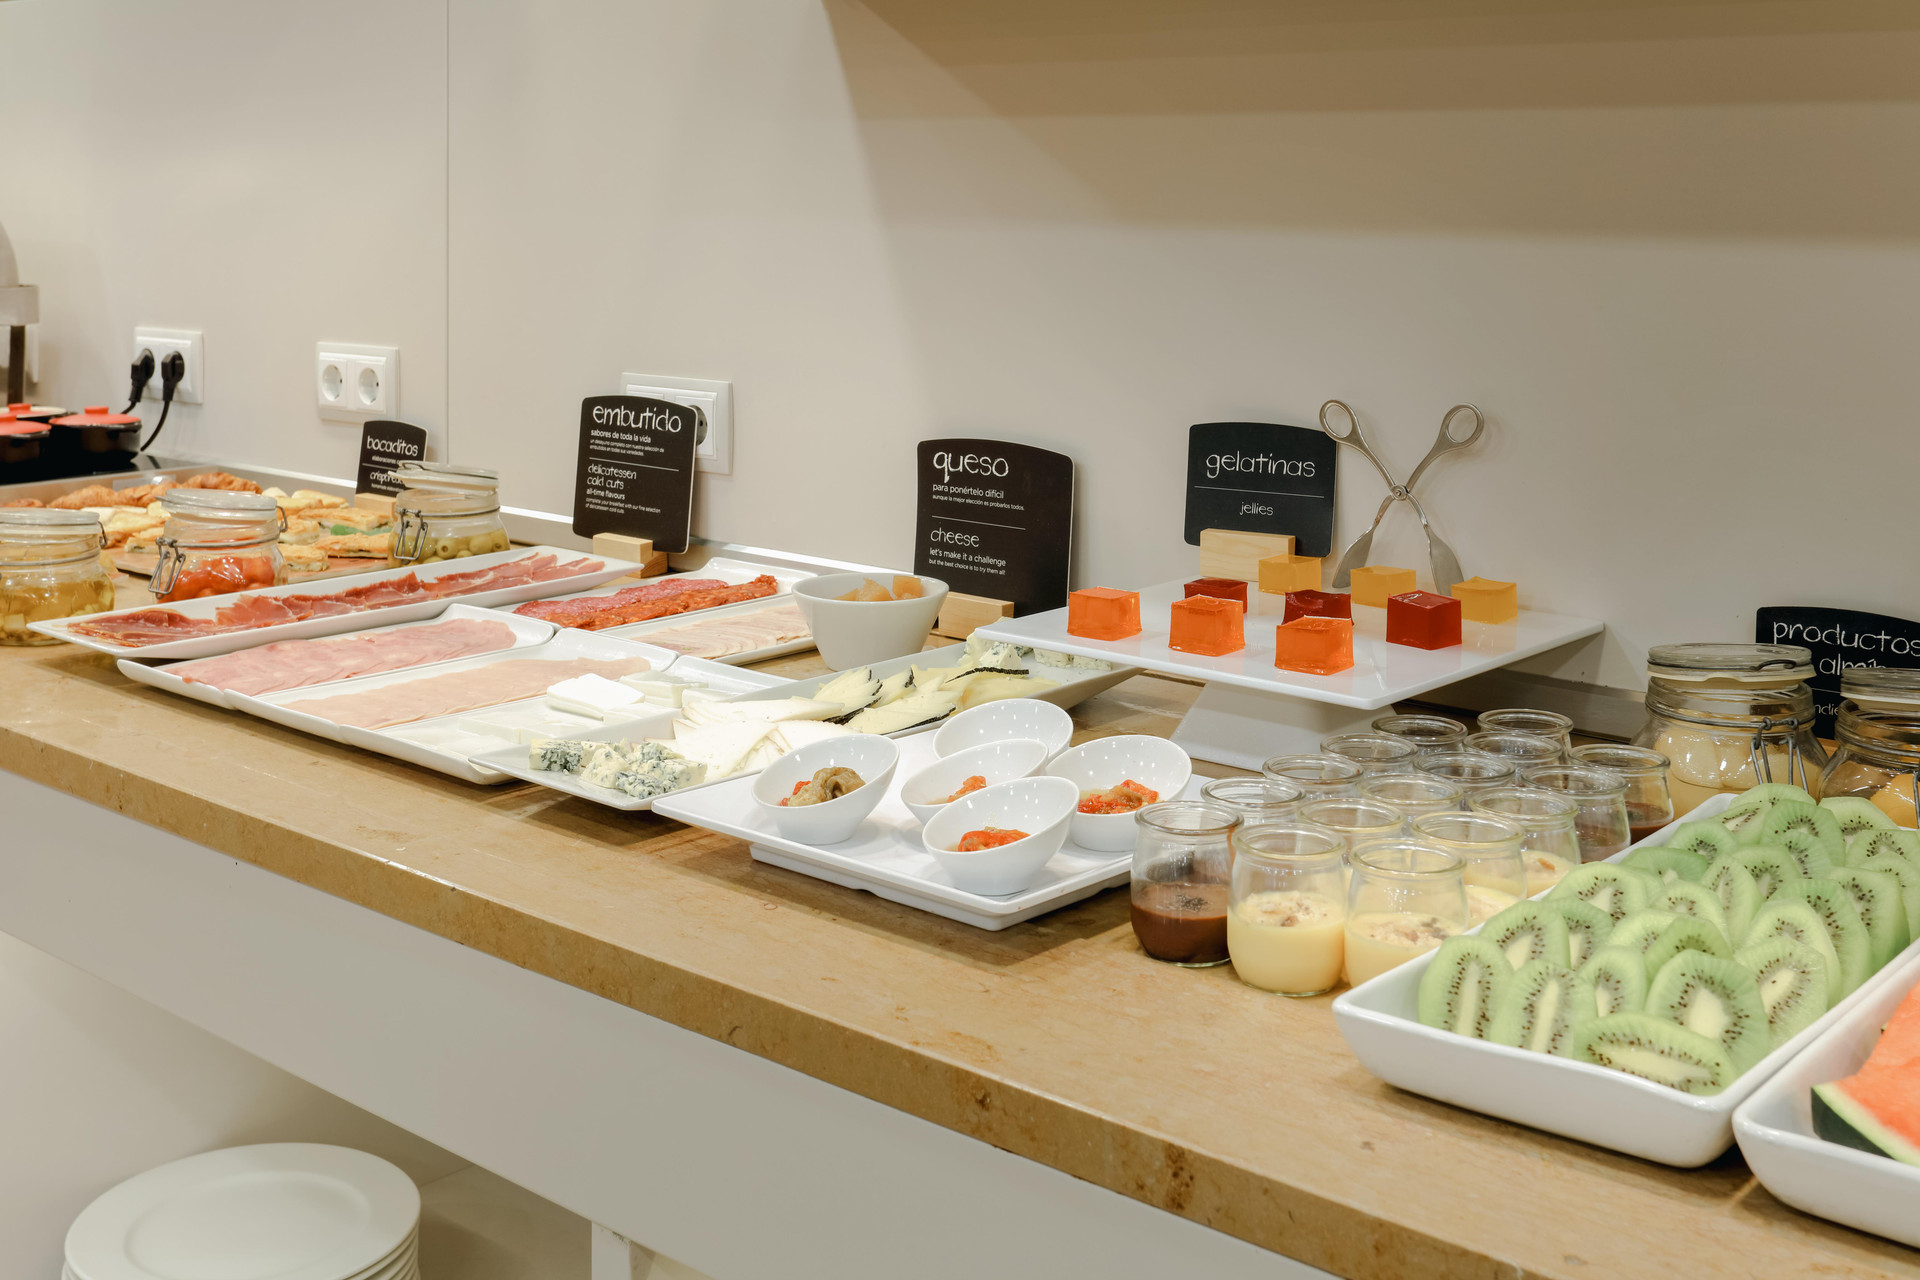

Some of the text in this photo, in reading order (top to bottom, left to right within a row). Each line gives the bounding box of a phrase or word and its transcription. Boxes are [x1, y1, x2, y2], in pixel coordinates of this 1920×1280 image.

[593, 405, 681, 432] embutido
[367, 435, 418, 456] bocaditos
[591, 429, 611, 438] sabores
[612, 431, 619, 439] de
[620, 432, 633, 440] toda
[640, 434, 651, 443] vida
[588, 464, 636, 479] delicatessen
[933, 452, 1008, 483] queso
[1206, 450, 1315, 478] gelatinas
[587, 476, 624, 490] cold cuts
[932, 484, 1004, 499] para ponértelo difícil
[586, 488, 625, 500] all-time flavours
[1240, 502, 1274, 516] jellies
[930, 528, 980, 547] cheese
[930, 547, 942, 556] let's
[944, 551, 961, 559] make
[963, 552, 967, 560] it
[974, 554, 1006, 567] challenge
[1774, 622, 1920, 656] productos
